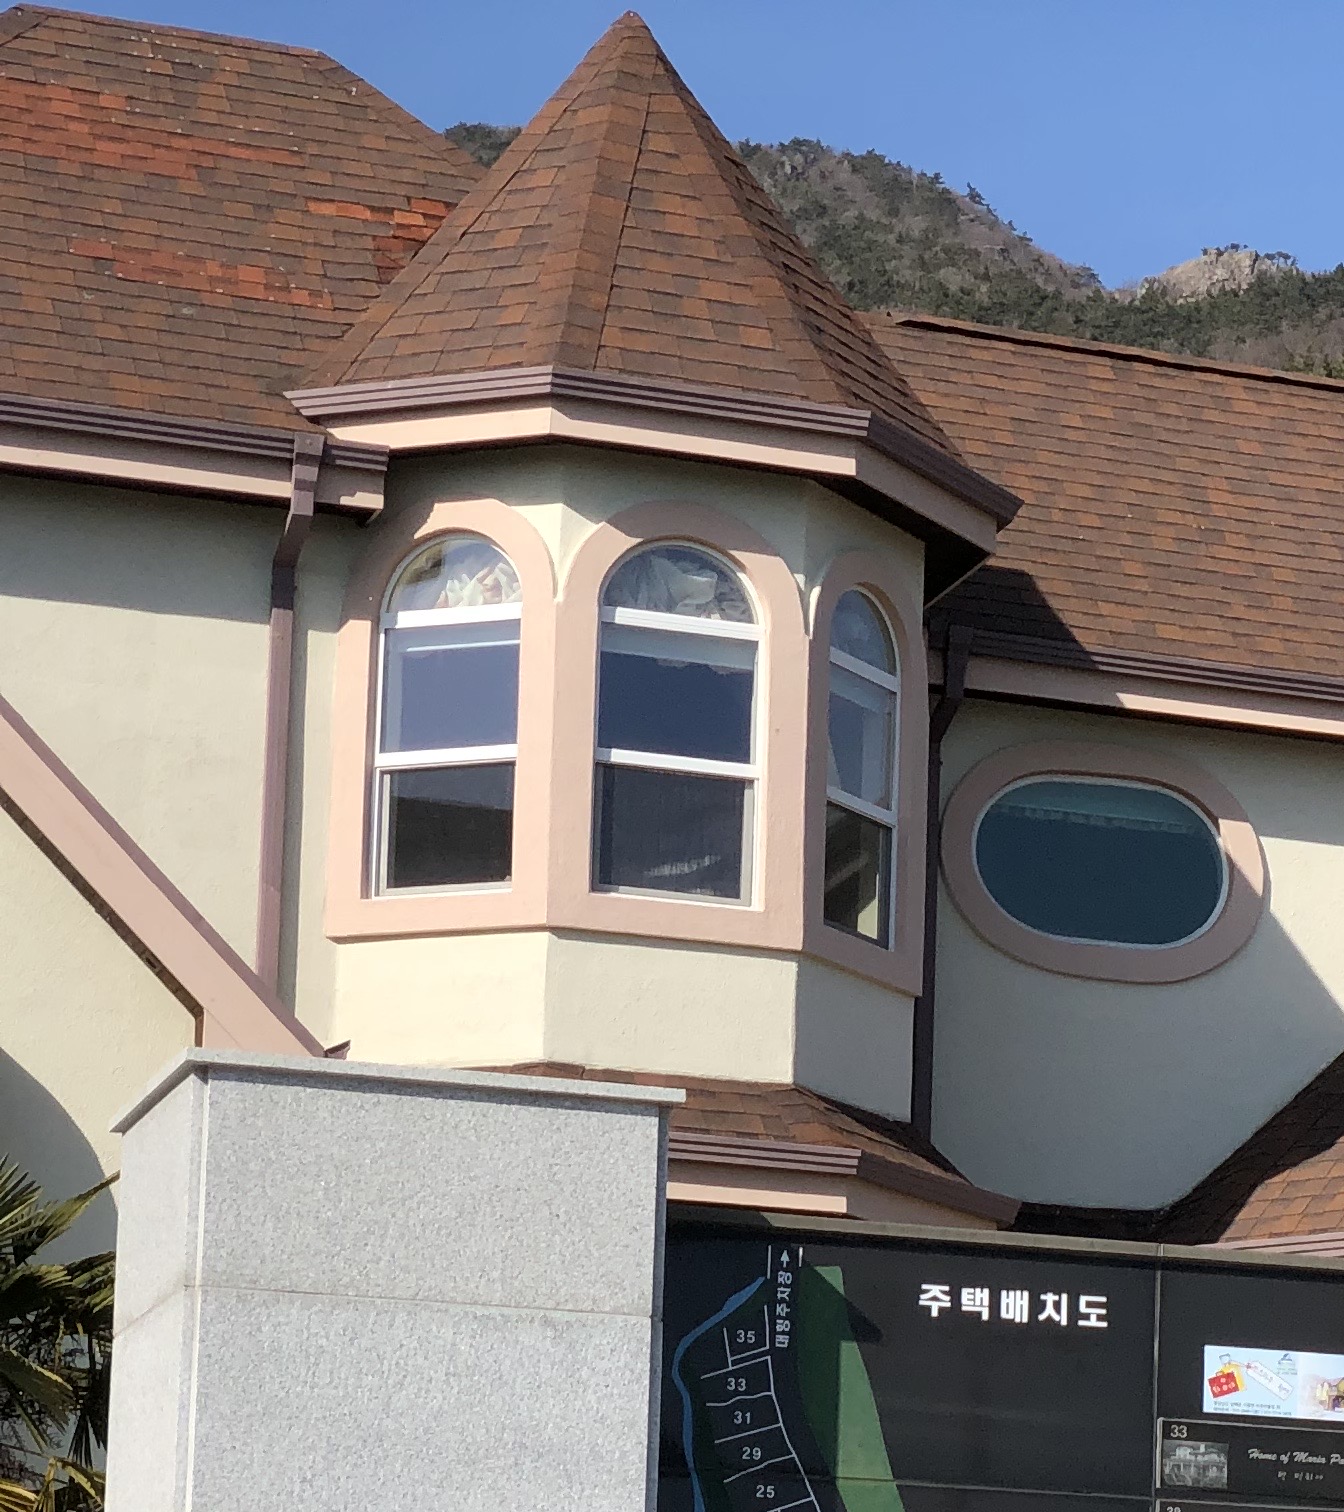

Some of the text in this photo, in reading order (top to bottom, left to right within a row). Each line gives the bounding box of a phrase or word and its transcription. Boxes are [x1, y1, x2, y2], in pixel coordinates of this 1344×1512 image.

[919, 1284, 1107, 1327] 주택배치도
[737, 1330, 755, 1343] 35
[727, 1378, 746, 1391] 33
[734, 1411, 750, 1424] 31
[1171, 1425, 1187, 1438] 33
[742, 1447, 761, 1460] 29
[756, 1485, 774, 1498] 25
